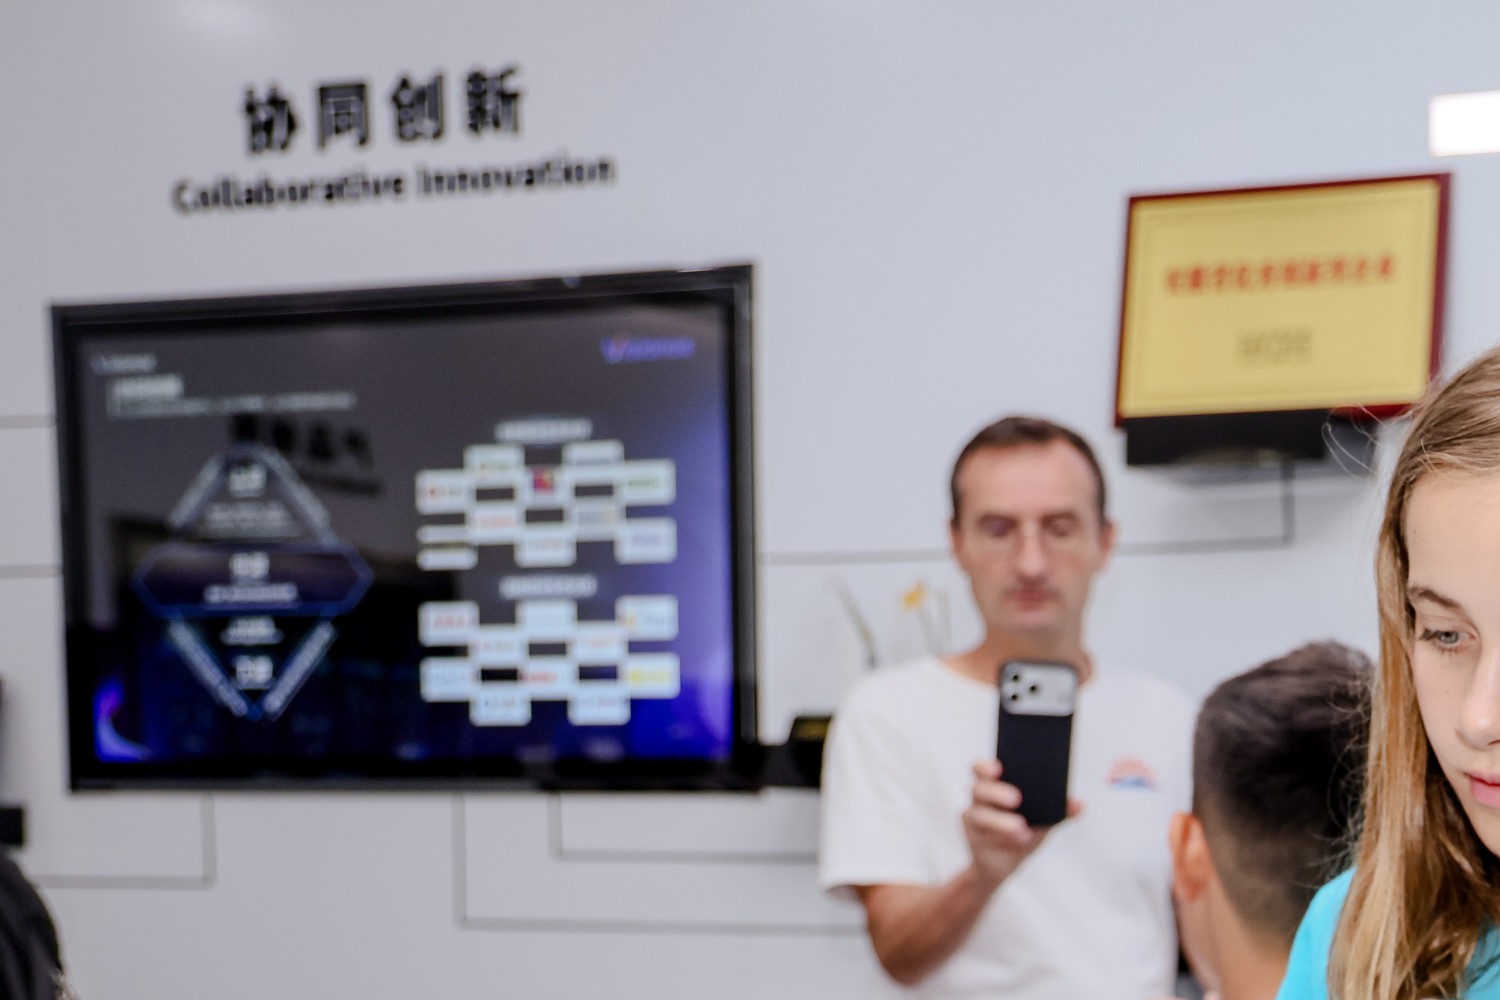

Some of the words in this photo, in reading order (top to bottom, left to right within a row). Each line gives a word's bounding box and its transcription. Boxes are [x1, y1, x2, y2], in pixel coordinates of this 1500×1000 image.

[243, 65, 523, 155] 协同创新
[173, 168, 405, 212] Collaborative
[418, 151, 615, 194] Innovation
